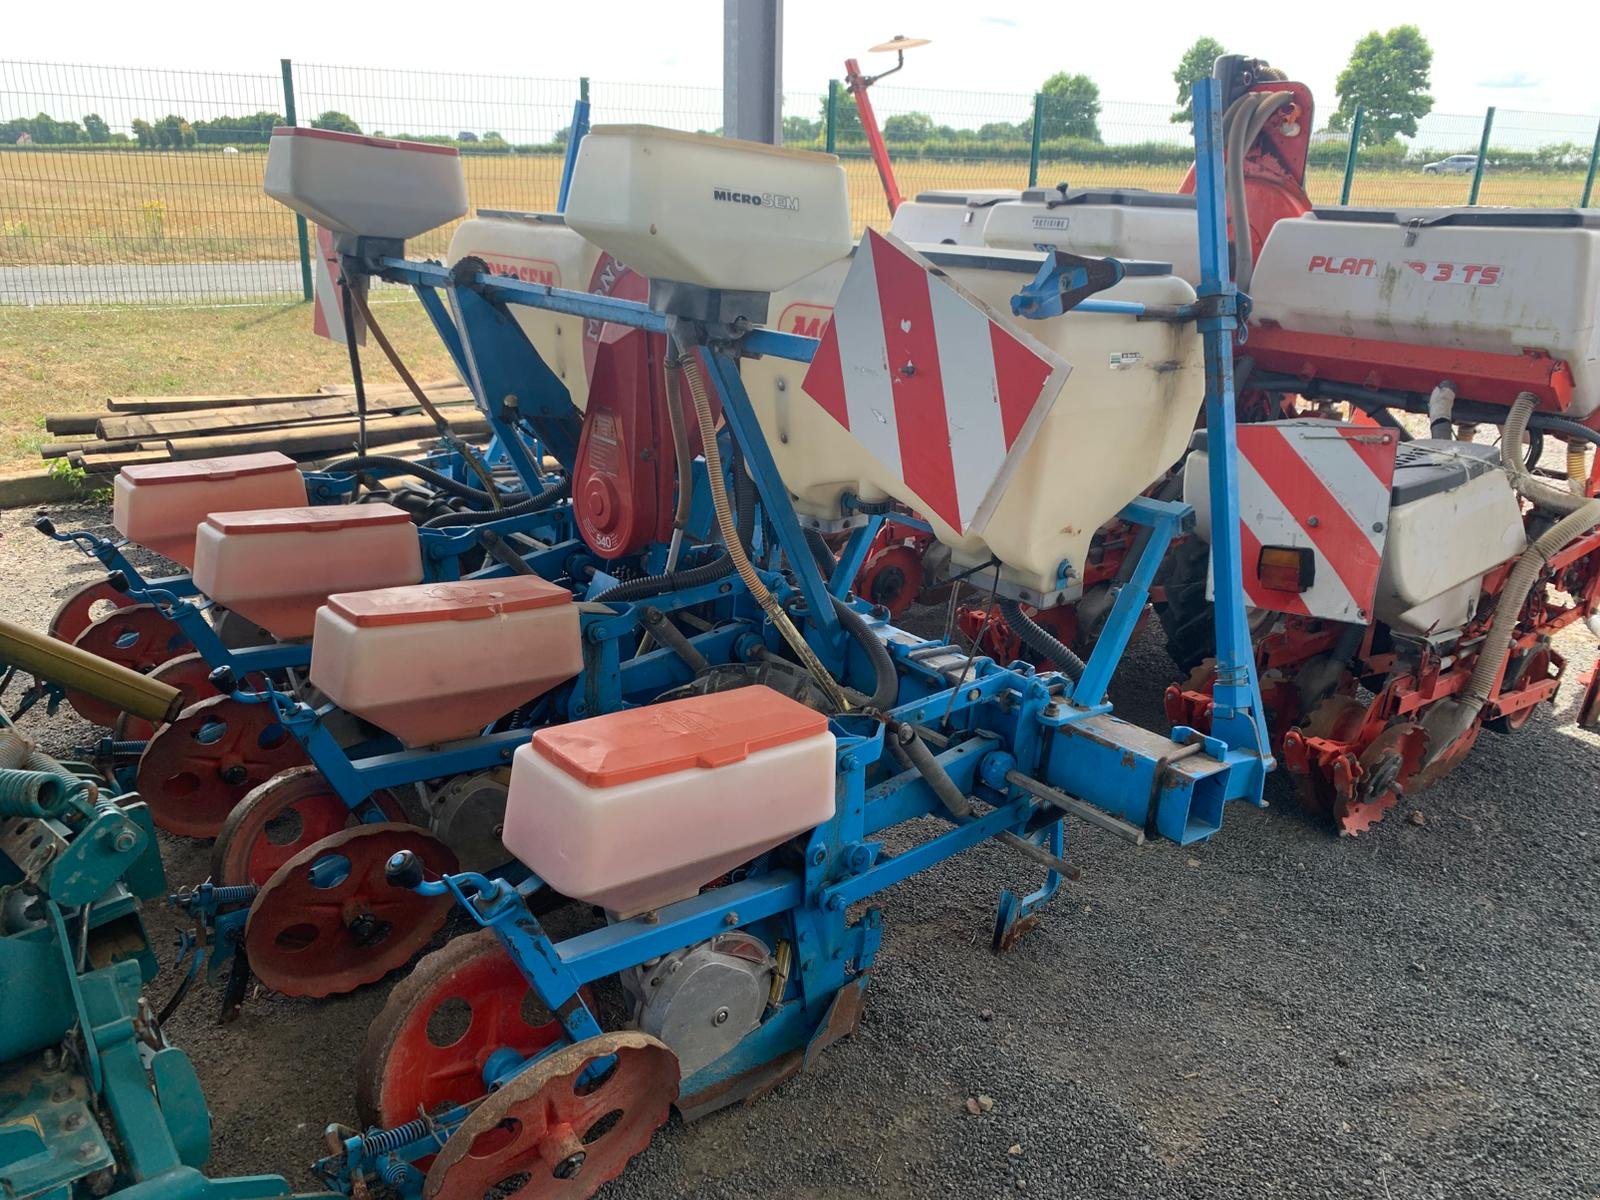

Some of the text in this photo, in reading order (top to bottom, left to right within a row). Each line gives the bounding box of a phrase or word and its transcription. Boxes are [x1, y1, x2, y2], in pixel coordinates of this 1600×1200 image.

[713, 190, 800, 211] MICROSEM
[1432, 263, 1455, 283] 3
[1462, 264, 1501, 286] TS
